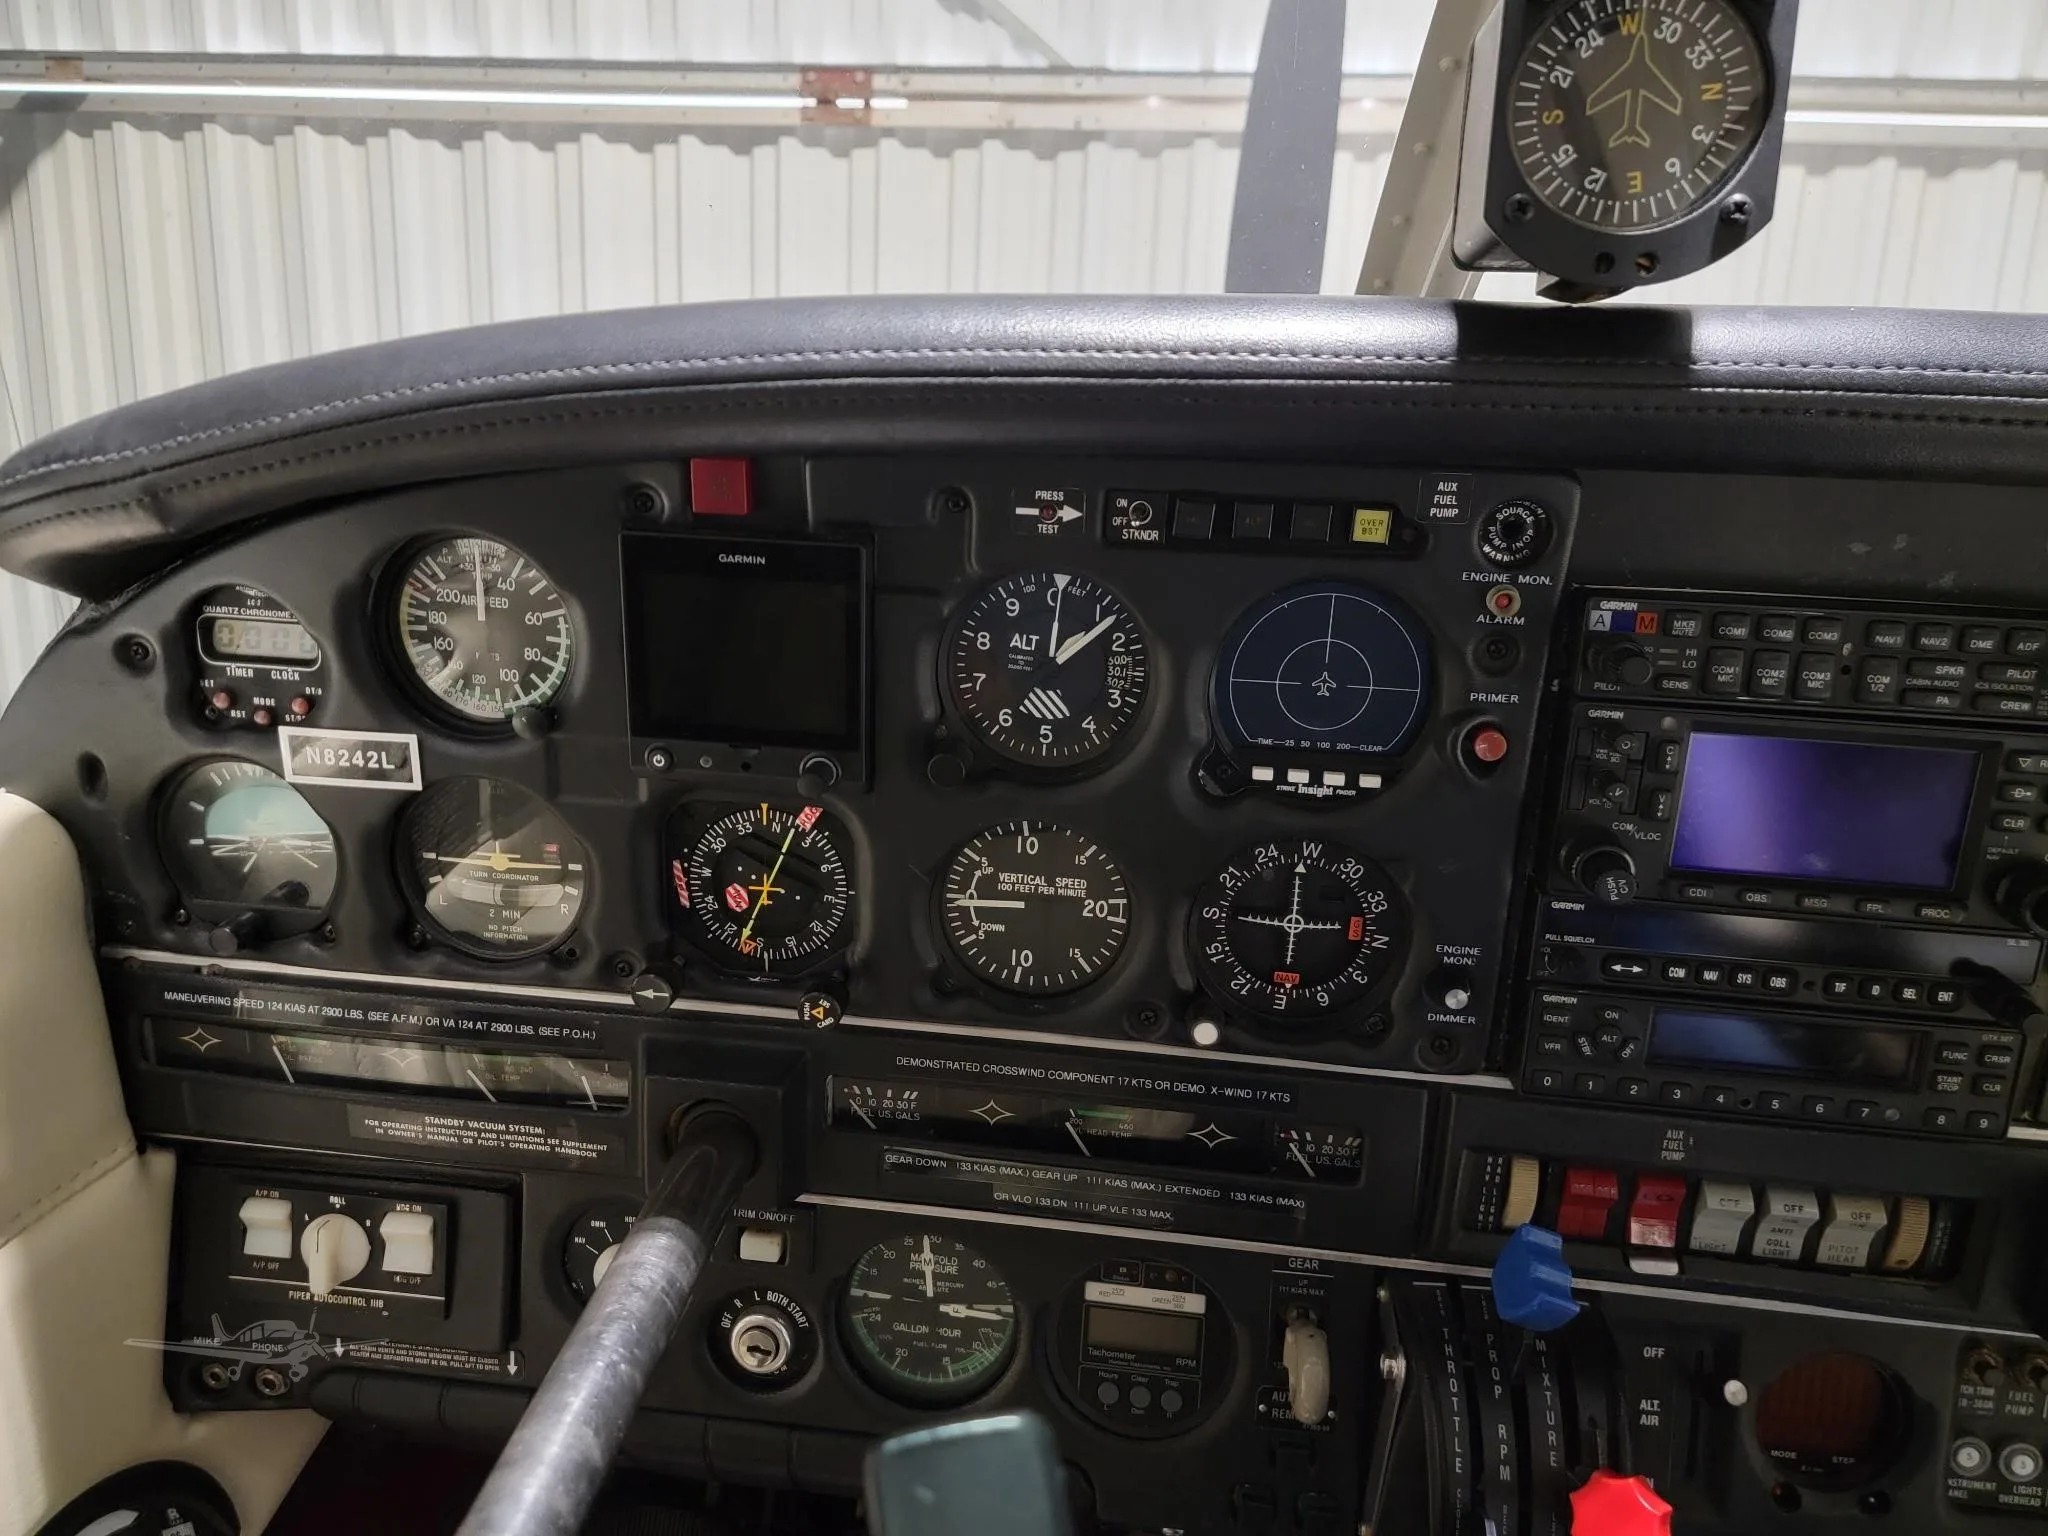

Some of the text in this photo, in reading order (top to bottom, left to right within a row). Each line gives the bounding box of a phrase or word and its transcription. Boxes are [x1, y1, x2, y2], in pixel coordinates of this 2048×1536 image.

[1654, 17, 1682, 43] 30
[1575, 28, 1603, 58] 24
[1686, 41, 1714, 69] 33
[1438, 482, 1458, 492] AUX
[1035, 491, 1064, 501] PRESS
[1434, 495, 1458, 504] FUEL
[1430, 508, 1458, 518] PUMP
[1359, 519, 1384, 528] OVER
[1038, 524, 1059, 534] TEST
[1122, 529, 1159, 541] STKNDR
[719, 554, 765, 565] GARMIN
[1462, 572, 1552, 585] ENGINE MON.
[437, 589, 460, 602] 200
[1068, 586, 1086, 597] FEET
[203, 605, 239, 615] QUARTZ
[1600, 601, 1638, 610] GARMIN
[429, 611, 446, 624] 180
[525, 612, 542, 625] 60
[1476, 614, 1524, 625] ALARM
[1763, 629, 1792, 638] COM2
[434, 637, 453, 650] 160
[976, 632, 990, 650] 8
[1010, 633, 1039, 651] ALT
[1112, 633, 1125, 651] 2
[1970, 640, 1993, 649] DME
[524, 649, 540, 661] 80
[226, 667, 253, 678] TIMER
[271, 670, 299, 680] CLOCK
[500, 669, 518, 682] 100
[1935, 666, 1964, 675] SPKR
[2006, 669, 2037, 678] PILOT
[472, 674, 486, 684] 120
[1867, 674, 1890, 684] COM
[1662, 680, 1689, 689] SENS
[254, 697, 275, 706] MODE
[1470, 692, 1519, 703] PRIMER
[2000, 701, 2031, 710] CREW
[999, 709, 1012, 726] 6
[1588, 710, 1624, 720] GARMIN
[1039, 725, 1052, 743] 5
[306, 747, 395, 769] N8242L
[1298, 784, 1333, 797] Insight
[2003, 819, 2024, 828] CLR
[736, 822, 752, 836] 33
[711, 838, 727, 853] 30
[1017, 836, 1039, 854] 10
[1340, 858, 1364, 879] 30
[493, 872, 539, 881] COORDINATOR
[999, 872, 1087, 888] VERTICAL SPEED
[1015, 884, 1086, 898] FEET PER MINUTE
[1689, 888, 1707, 897] CDI
[1746, 893, 1767, 903] OBS
[1804, 898, 1827, 908] MSG
[561, 904, 569, 914] R
[1083, 900, 1107, 917] 20
[1551, 901, 1585, 911] GARMIN
[503, 910, 520, 918] MIN
[1921, 908, 1950, 918] PROC
[981, 923, 1004, 932] DOWN
[484, 932, 528, 940] INFORMATION
[1436, 944, 1481, 956] ENGINE
[1012, 949, 1032, 967] 10
[1353, 970, 1368, 984] 3
[1668, 967, 1685, 978] COM
[1704, 971, 1718, 981] NAV
[1737, 974, 1751, 984] SYS
[1770, 977, 1786, 987] OBS
[1543, 994, 1577, 1004] GARMIN
[1938, 992, 1954, 1001] ENT
[164, 991, 560, 1037] MANEUVERING SPEED 124 KIAS 2900 LBS. 124 2900 LBS. (SEE
[1428, 1013, 1476, 1024] DIMMER
[1544, 1015, 1569, 1023] IDENT
[1942, 1051, 1968, 1060] FUNC
[1985, 1055, 2010, 1064] CRSR
[896, 1056, 1290, 1102] DEMONSTRATED CROSSWIND COMPONENT KTS KTS
[895, 1111, 920, 1121] GALS
[425, 1116, 505, 1130] STANDBY VACUUM
[382, 1122, 608, 1151] OPERATING INSTRUCTIONS LIMITATIONS SUPPLEMENT
[1666, 1130, 1684, 1140] AUX
[509, 1142, 550, 1151] OPERATING
[1322, 1145, 1333, 1154] 20
[1663, 1140, 1684, 1150] FUEL
[1661, 1151, 1686, 1160] PUMP
[1335, 1158, 1360, 1167] GALS
[886, 1154, 1273, 1204] GEAR DOWN KIAS GEAR KIAS EXTENDED 133 KIAS
[330, 1196, 345, 1205] ROLL
[1012, 1194, 1128, 1214] VLO VLE
[1784, 1204, 1804, 1213] OFF
[758, 1211, 796, 1223] ON/OFF
[1851, 1212, 1872, 1221] OFF
[1766, 1239, 1790, 1248] COLL
[1288, 1257, 1320, 1270] GEAR
[289, 1290, 367, 1306] PIPER AUTOCONTROL
[766, 1290, 789, 1307] BOTH
[720, 1311, 732, 1328] OFF
[893, 1323, 929, 1334] GALLON
[193, 1336, 221, 1345] MIKE
[252, 1342, 284, 1352] PHONE
[896, 1348, 908, 1357] 20
[1088, 1347, 1136, 1360] Tachometer
[1176, 1358, 1196, 1368] RPM
[1643, 1347, 1665, 1358] OFF
[942, 1357, 950, 1365] 15
[1098, 1370, 1118, 1380] Hours
[1442, 1328, 1463, 1473] THROTTLE
[2008, 1391, 2034, 1402] FUEL
[2005, 1405, 2035, 1416] PUMP
[1639, 1415, 1659, 1426] AIR
[1771, 1450, 1797, 1459] MODE
[2013, 1486, 2042, 1495] LIGHTS
